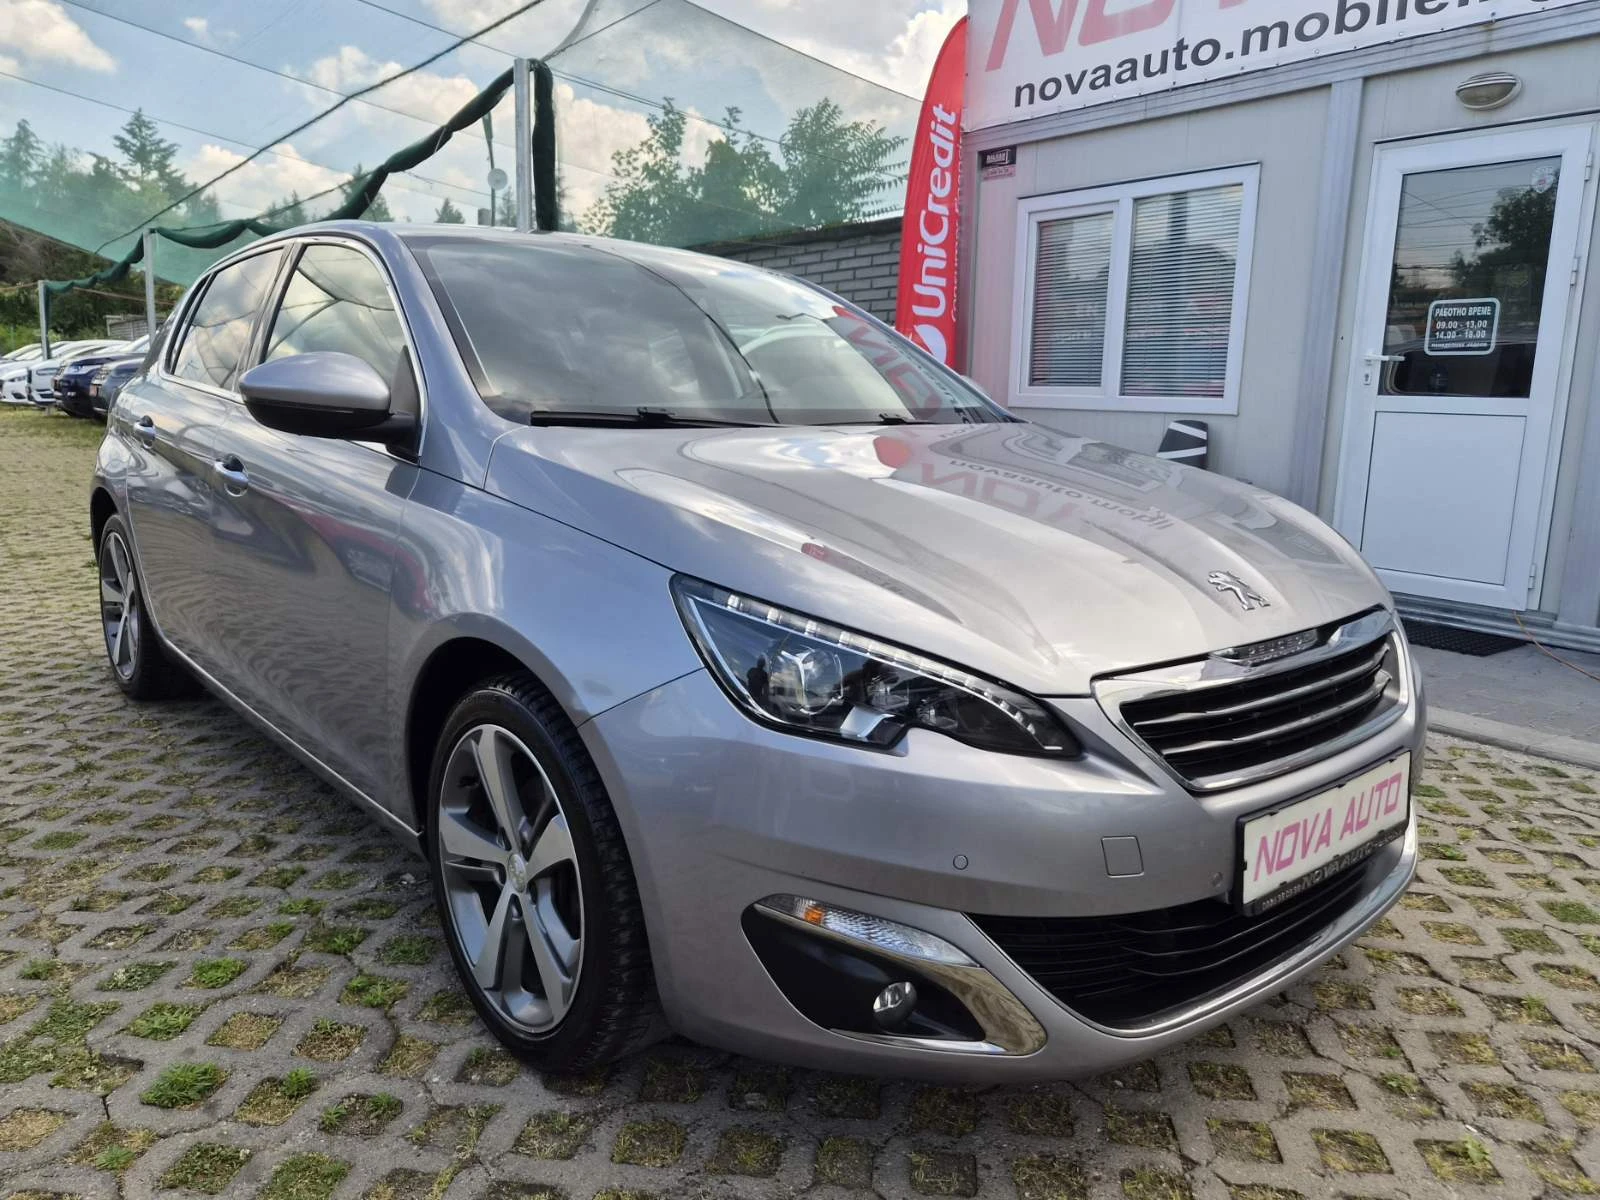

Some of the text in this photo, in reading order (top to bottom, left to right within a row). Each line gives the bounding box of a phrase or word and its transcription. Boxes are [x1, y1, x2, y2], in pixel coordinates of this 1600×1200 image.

[911, 103, 957, 318] UniCredit
[1435, 306, 1492, 317] РАБОТНО ВРЕМЕ
[1436, 321, 1458, 329] 09.00
[1253, 771, 1403, 881] NOVA AUTO
